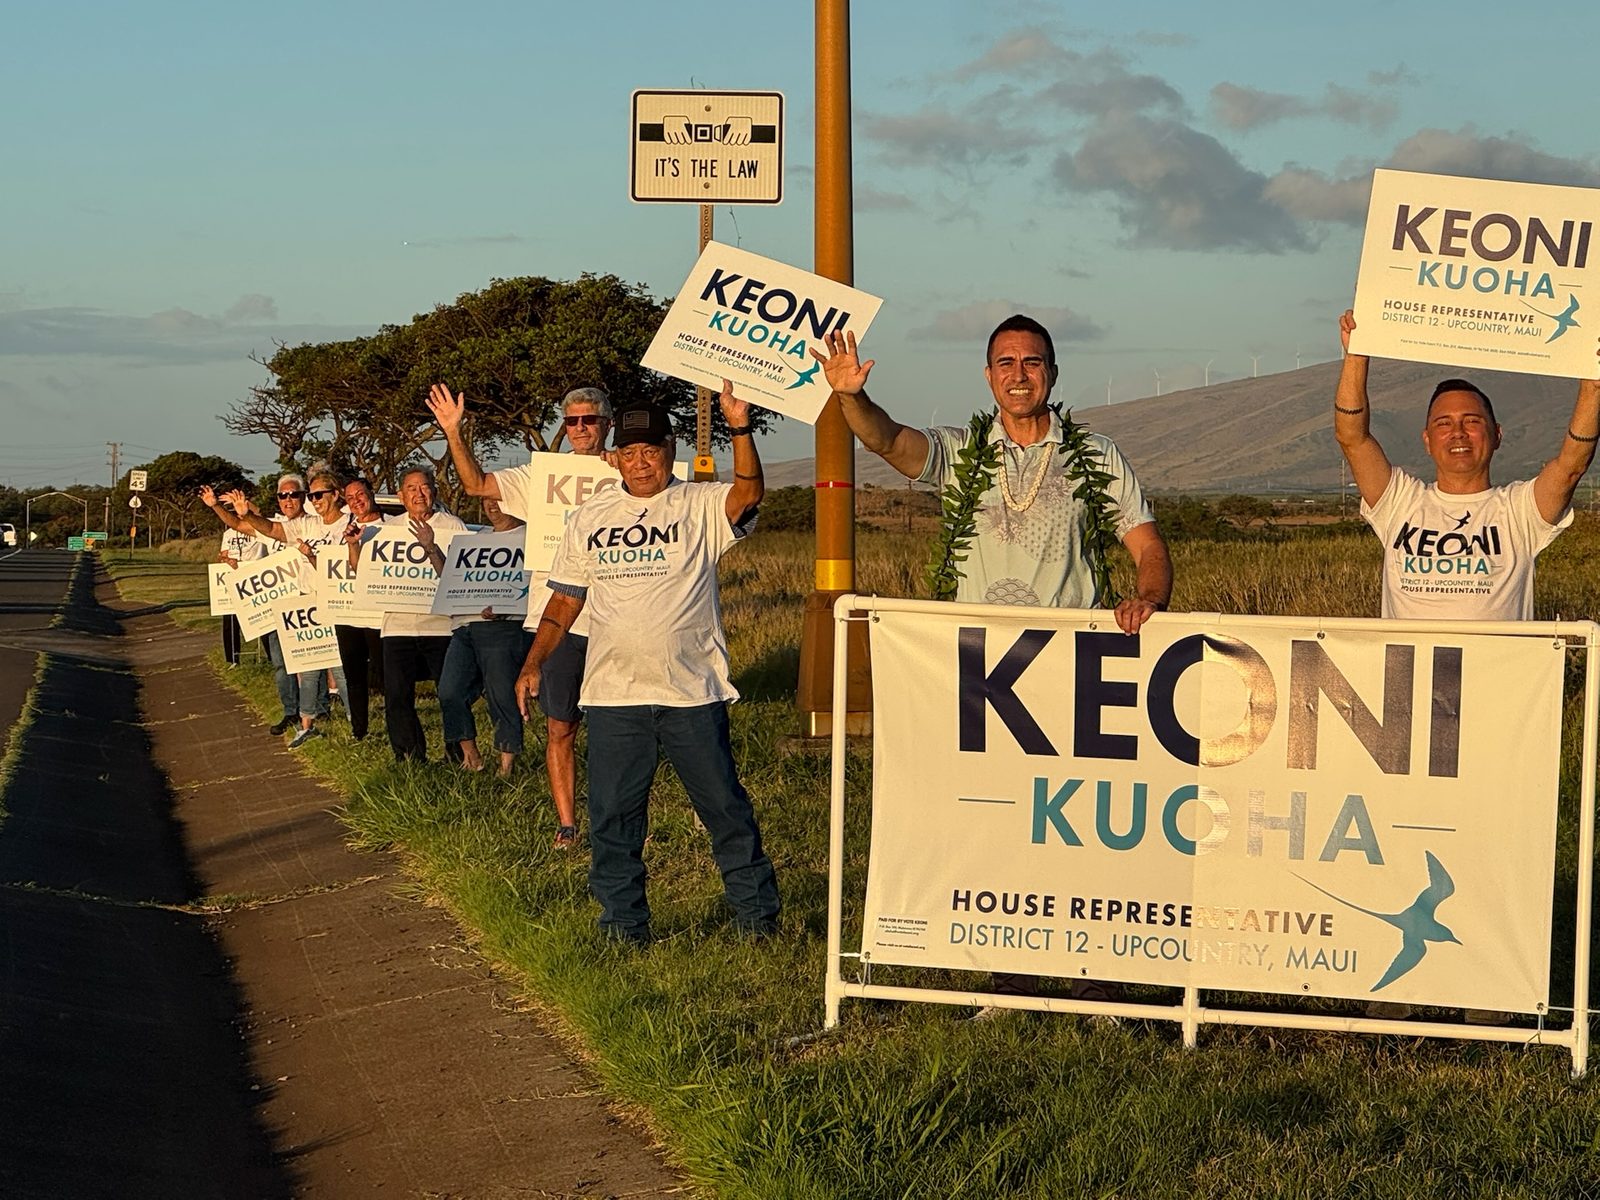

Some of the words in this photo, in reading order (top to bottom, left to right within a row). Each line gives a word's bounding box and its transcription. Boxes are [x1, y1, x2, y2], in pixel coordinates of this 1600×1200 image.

[655, 157, 680, 178] IT'S
[690, 159, 718, 178] THE
[728, 160, 759, 178] LAW
[1391, 204, 1593, 269] KEONI
[1417, 260, 1556, 300] KUOHA
[699, 268, 851, 343] KEONI
[1383, 299, 1427, 313] HOUSE
[1431, 305, 1535, 324] REPRESENTATIVE
[708, 310, 807, 360] KUOHA
[1382, 312, 1425, 324] DISTRICT
[1428, 317, 1439, 327] 12
[1447, 319, 1512, 335] UPCOUNTRY,
[1514, 327, 1542, 337] MAUI
[673, 341, 704, 355] DISTRICT
[705, 350, 714, 359] 12
[718, 355, 763, 377] UPCOUNTRY,
[764, 372, 786, 385] MAUI
[678, 332, 709, 347] HOUSE
[711, 343, 784, 373] REPRESENTATIVE
[131, 480, 145, 488] 45
[587, 521, 679, 551] KEONI
[1393, 521, 1502, 557] KEONI
[598, 548, 667, 565] KUOHA
[1404, 557, 1489, 575] KUOHA
[464, 570, 523, 582] KUOHA
[616, 571, 668, 579] REPRESENTATIVE
[1425, 586, 1492, 594] REPRESENTATIVE
[251, 582, 298, 608] KUOHA
[958, 626, 1464, 778] KEONI
[1031, 776, 1385, 866] KUOHA
[952, 889, 1056, 917] HOUSE
[1070, 897, 1334, 937] REPRESENTATIVE
[950, 922, 1055, 951] DISTRICT
[1065, 930, 1089, 954] 12
[1112, 933, 1274, 972] UPCOUNTRY,
[1285, 945, 1358, 973] MAUI
